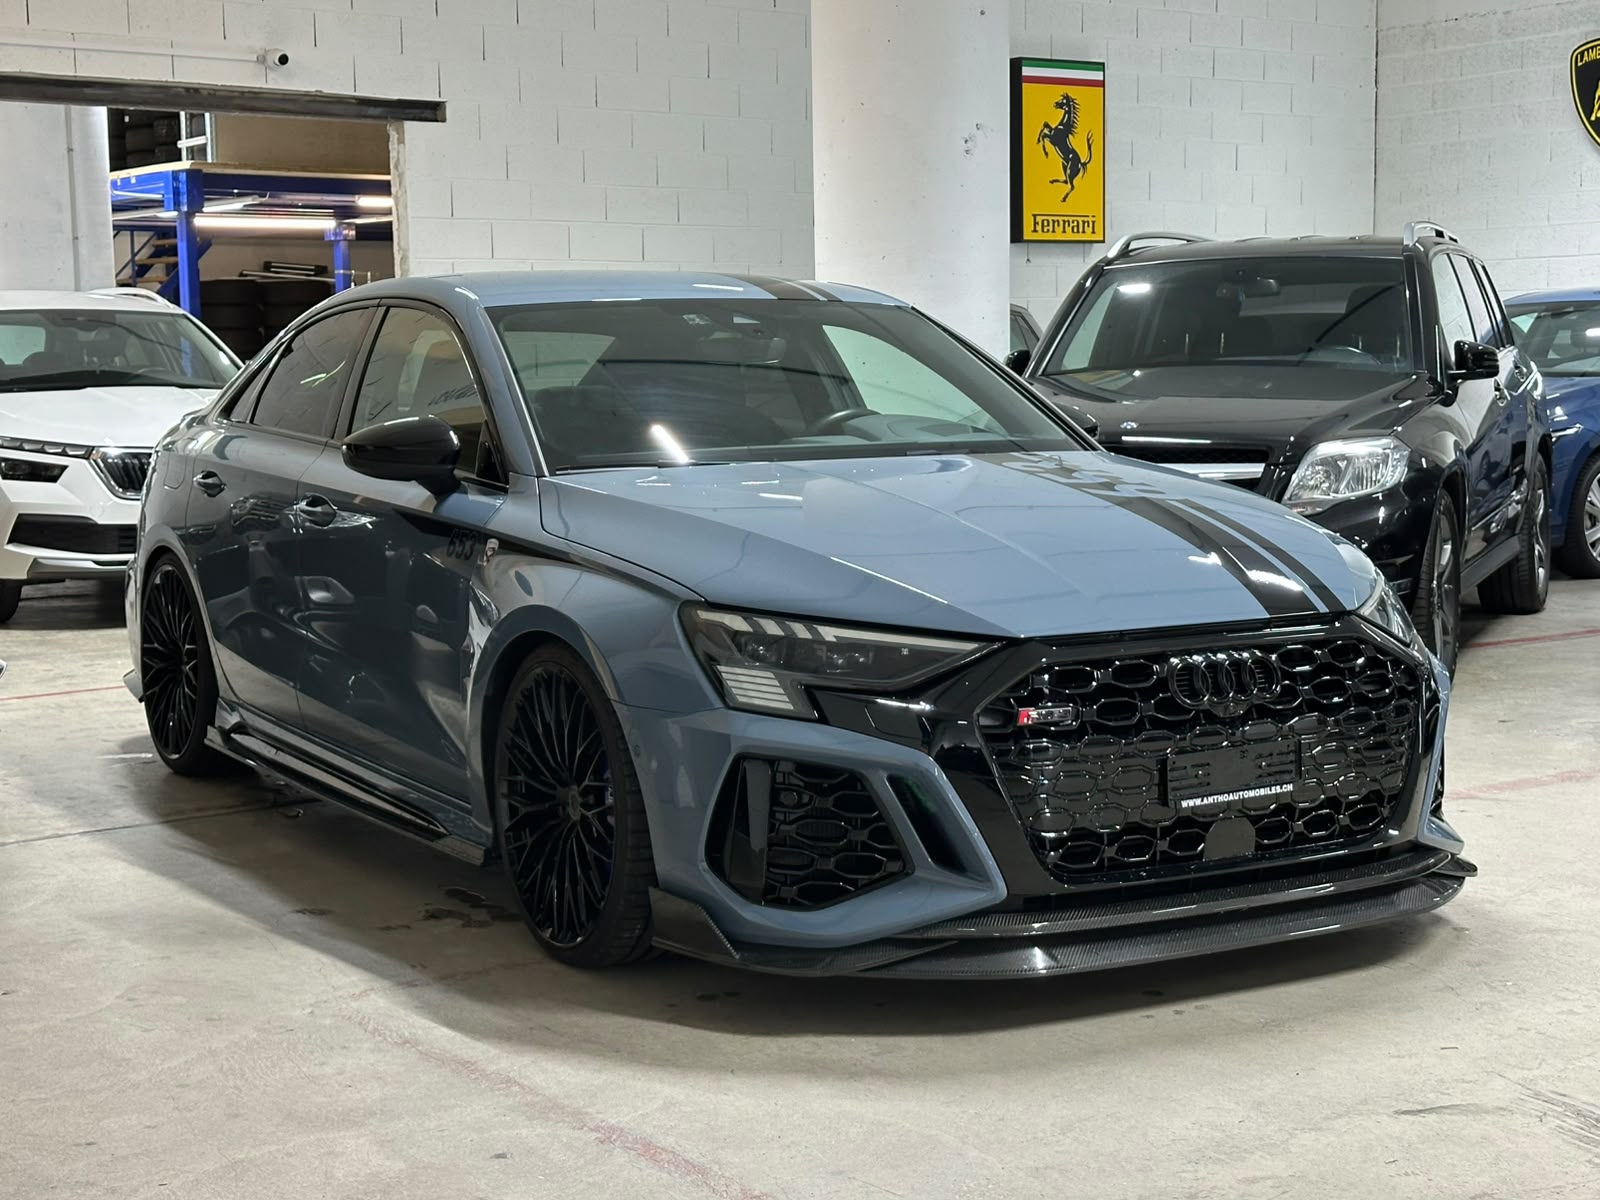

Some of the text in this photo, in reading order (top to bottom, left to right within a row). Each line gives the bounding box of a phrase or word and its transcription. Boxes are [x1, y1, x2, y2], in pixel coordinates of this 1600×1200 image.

[1031, 213, 1096, 234] Ferrari
[447, 528, 478, 560] 653
[1181, 783, 1293, 808] WWW.ANTHOAUTOMOBILES.CH
